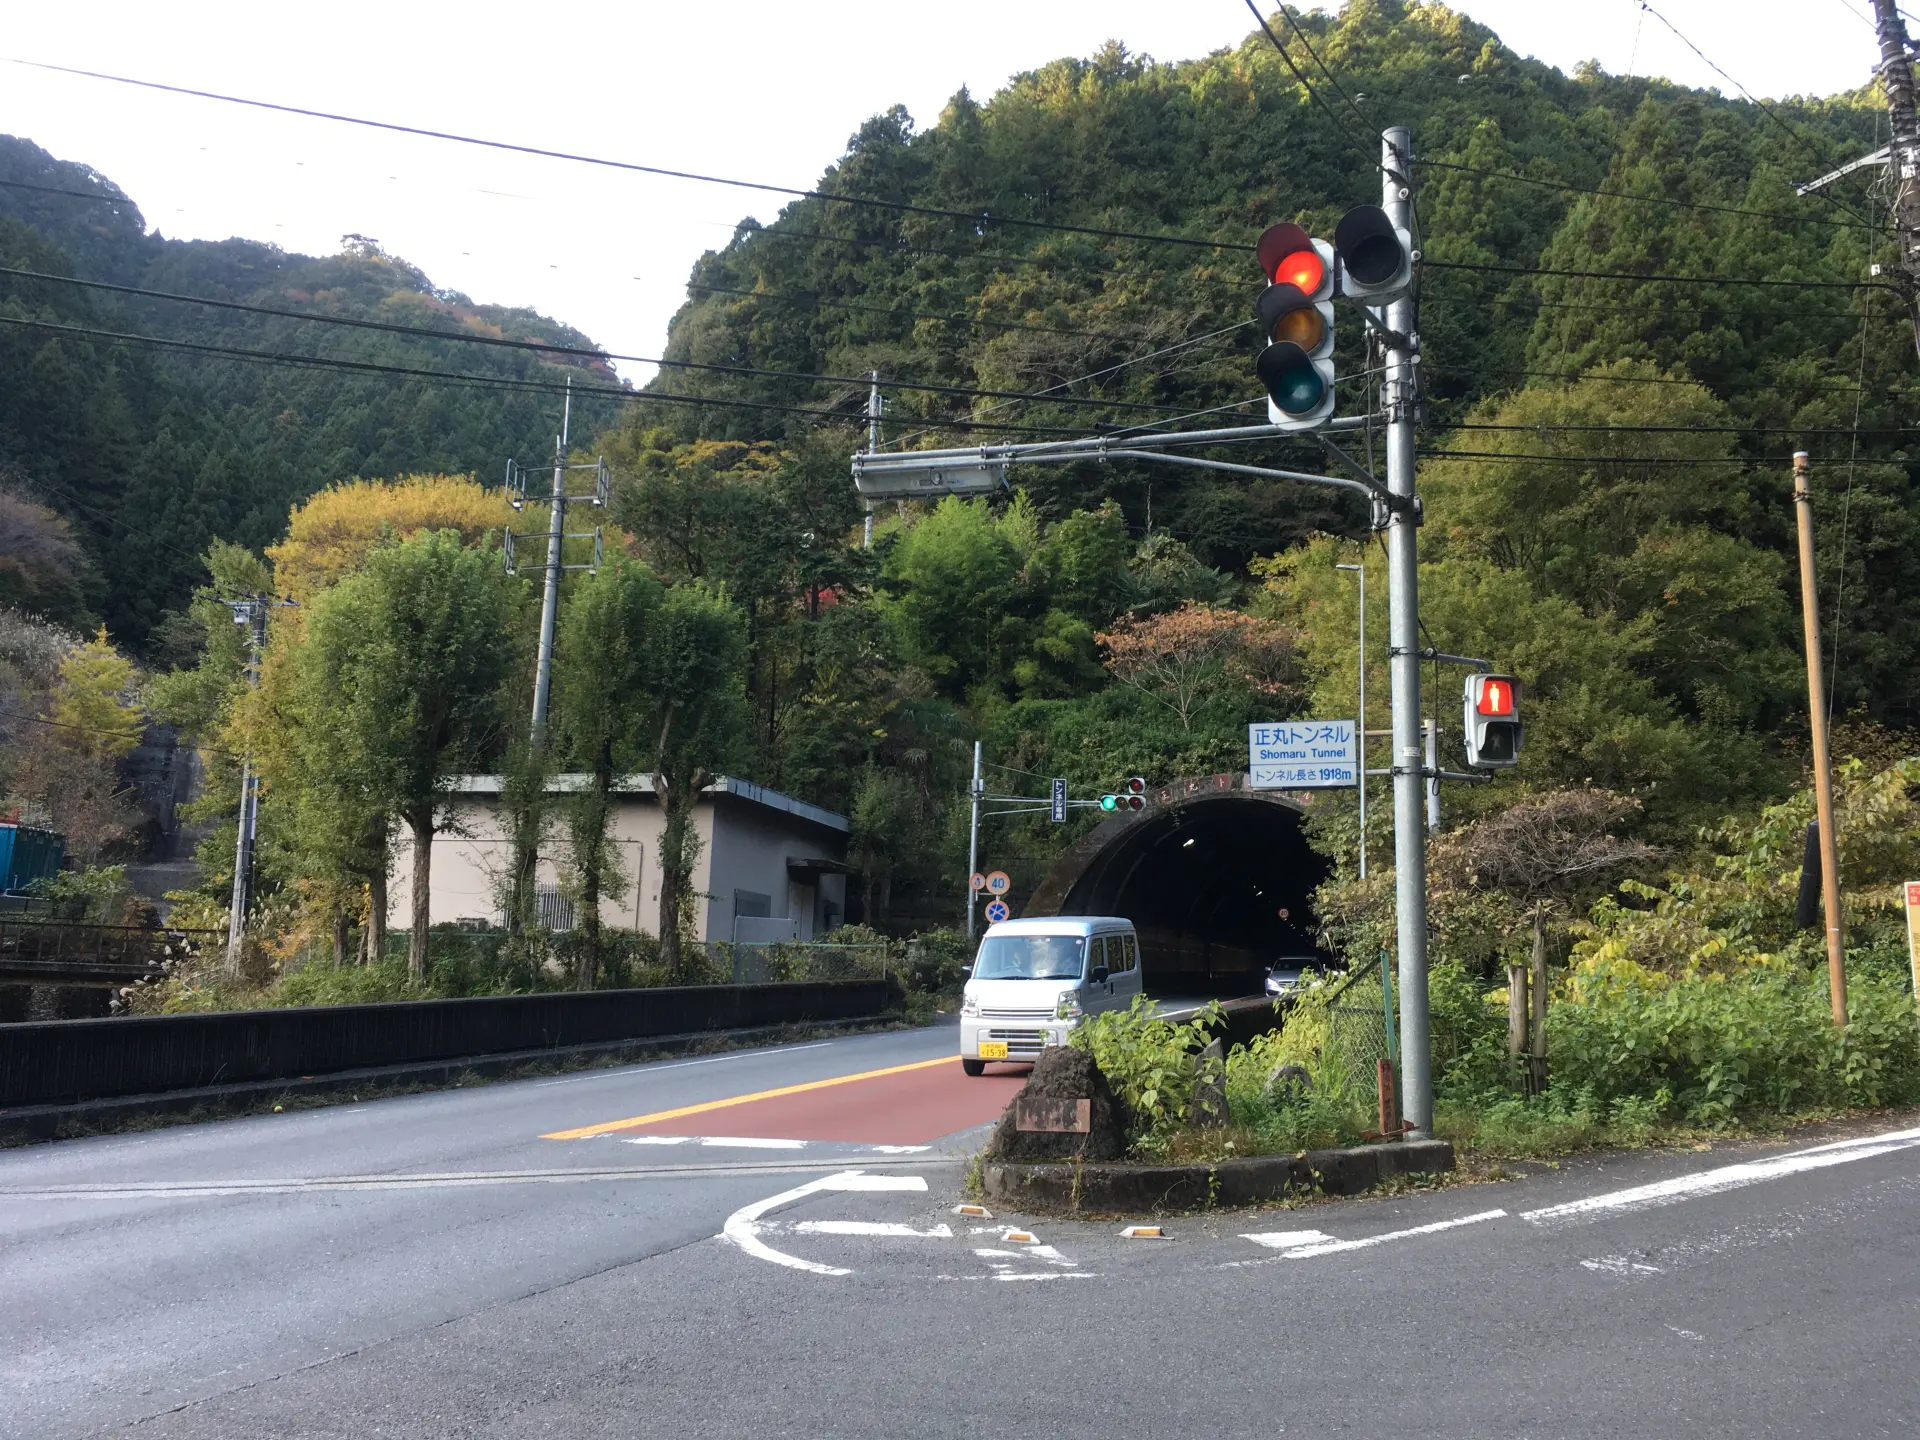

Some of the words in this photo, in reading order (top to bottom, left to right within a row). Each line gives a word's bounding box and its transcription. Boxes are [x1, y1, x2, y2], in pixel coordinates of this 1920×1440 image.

[1255, 725, 1350, 746] 正丸トンネル
[1260, 749, 1306, 760] Shomaru
[1311, 748, 1346, 758] Tunnel
[1256, 769, 1316, 782] トンネル長さ
[1319, 768, 1351, 780] 1918m
[1055, 781, 1063, 820] トンネル専用
[992, 878, 1005, 888] 40
